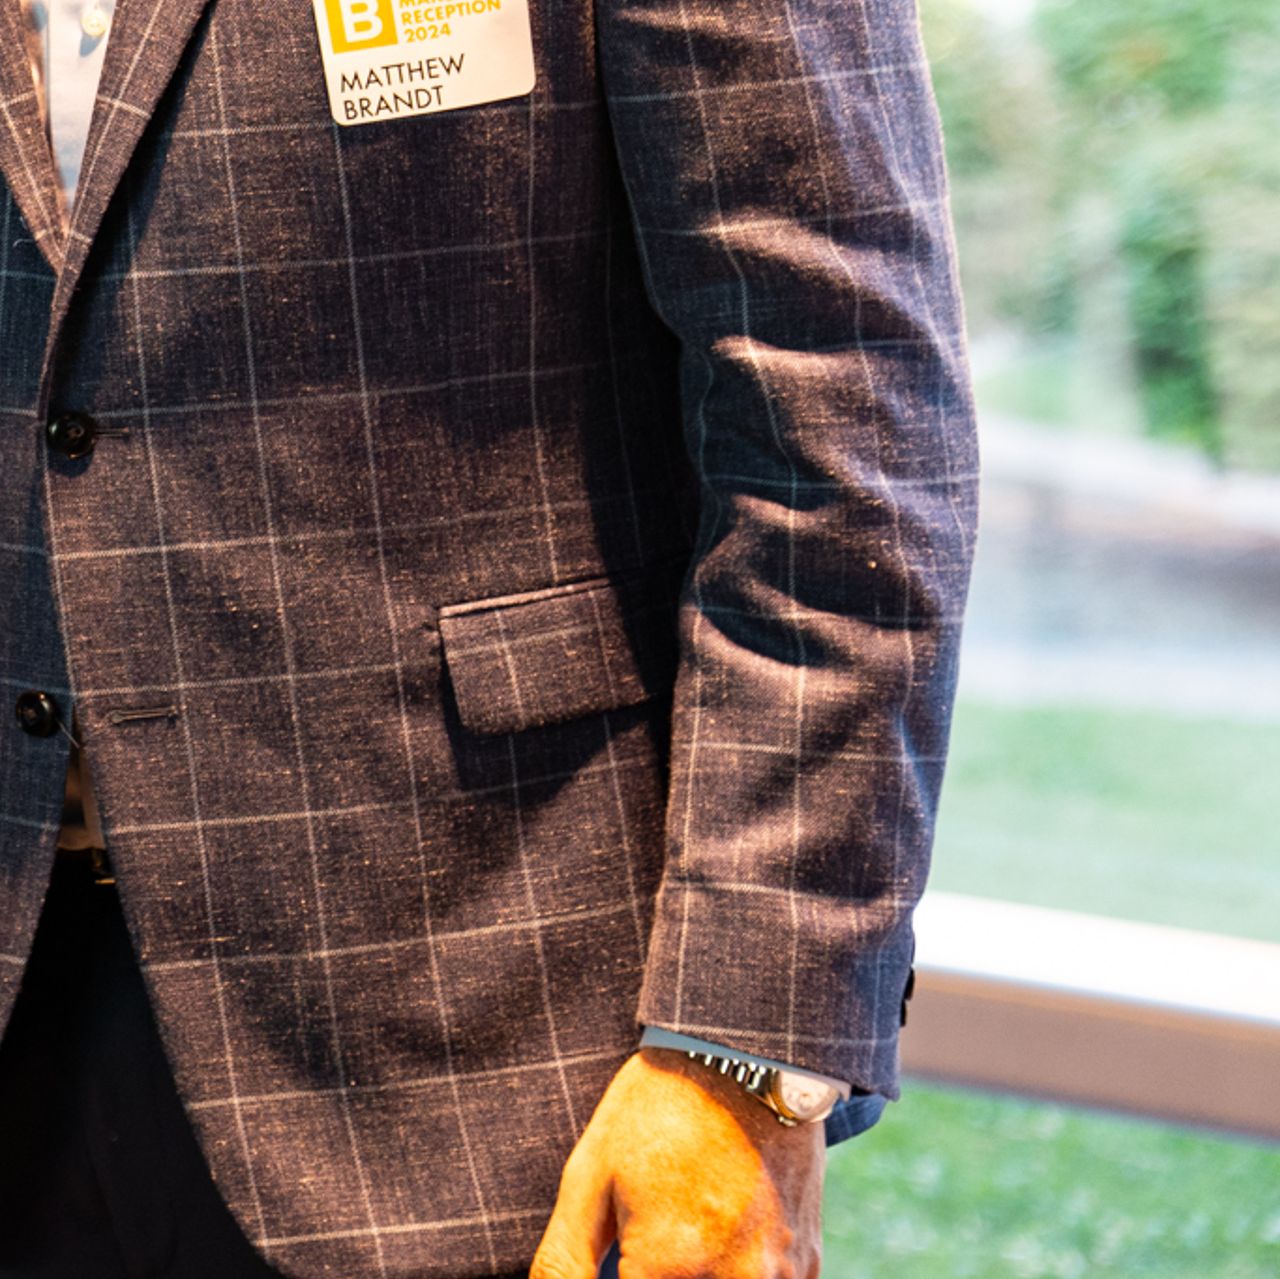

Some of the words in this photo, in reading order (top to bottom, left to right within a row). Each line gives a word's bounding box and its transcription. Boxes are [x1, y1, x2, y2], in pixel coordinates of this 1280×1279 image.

[404, 24, 452, 43] 2024
[340, 53, 466, 94] MATTHEW
[344, 85, 444, 121] BRANDT
